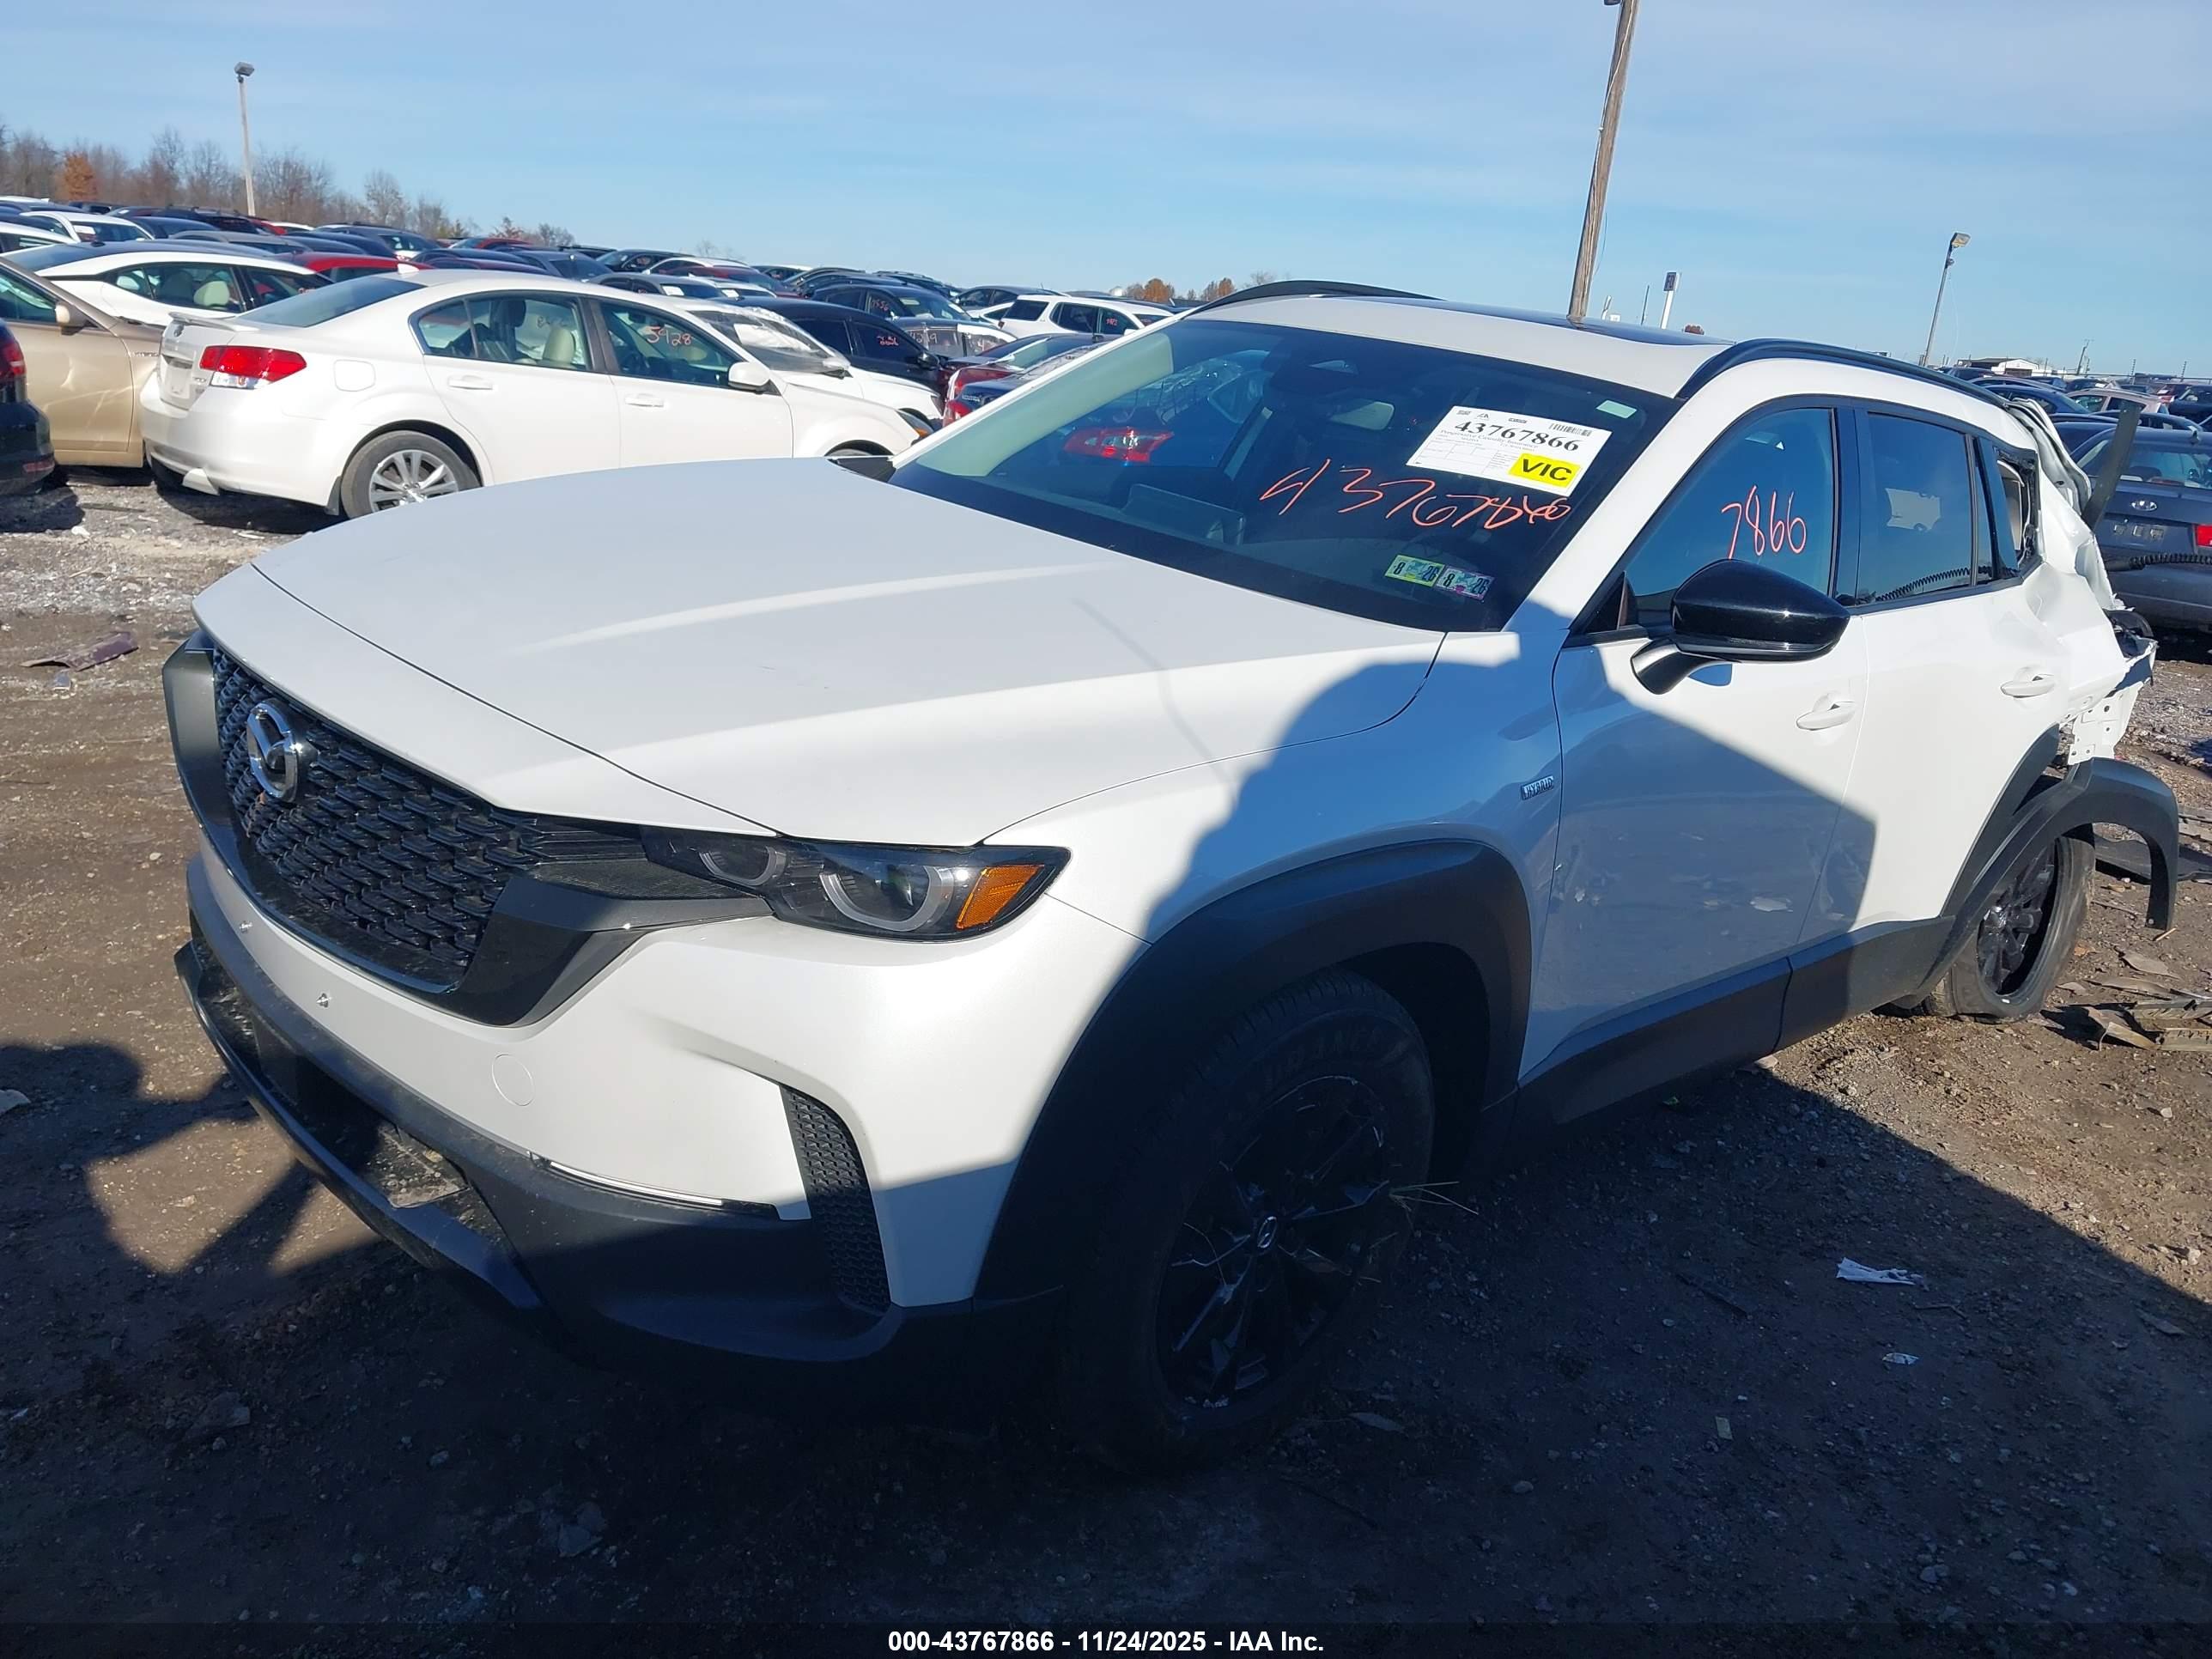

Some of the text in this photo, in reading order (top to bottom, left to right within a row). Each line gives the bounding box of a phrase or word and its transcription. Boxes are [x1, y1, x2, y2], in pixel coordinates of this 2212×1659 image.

[1455, 421, 1580, 451] 43767866
[1522, 459, 1572, 482] VIC
[1721, 484, 1807, 560] 7866
[1394, 562, 1406, 575] 8
[1443, 573, 1455, 587] 8
[1523, 776, 1554, 800] HYBRID
